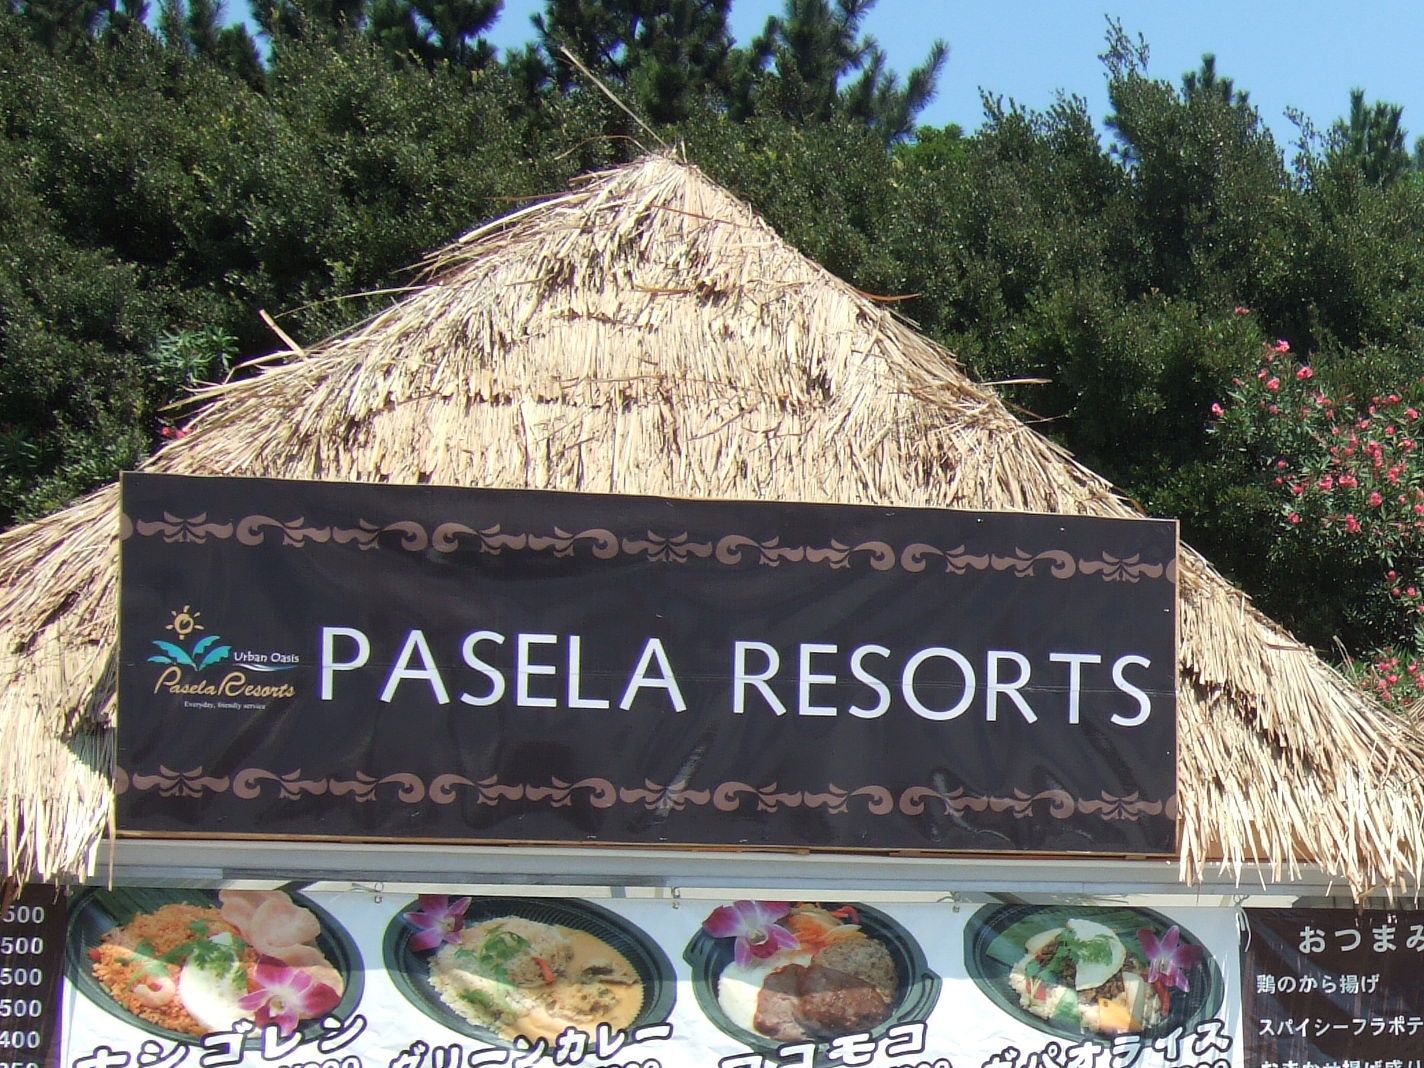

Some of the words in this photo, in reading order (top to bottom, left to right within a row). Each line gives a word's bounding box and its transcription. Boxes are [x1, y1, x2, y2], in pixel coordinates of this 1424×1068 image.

[234, 650, 267, 663] Urban
[271, 652, 300, 664] Oasis
[153, 666, 218, 696] Pasela
[217, 671, 296, 698] Resorts
[320, 626, 687, 712] PASELA
[732, 640, 1152, 727] RESORTS
[1256, 973, 1380, 995] 鶏のから揚げ
[1258, 1016, 1424, 1037] スパイシーフラポテ
